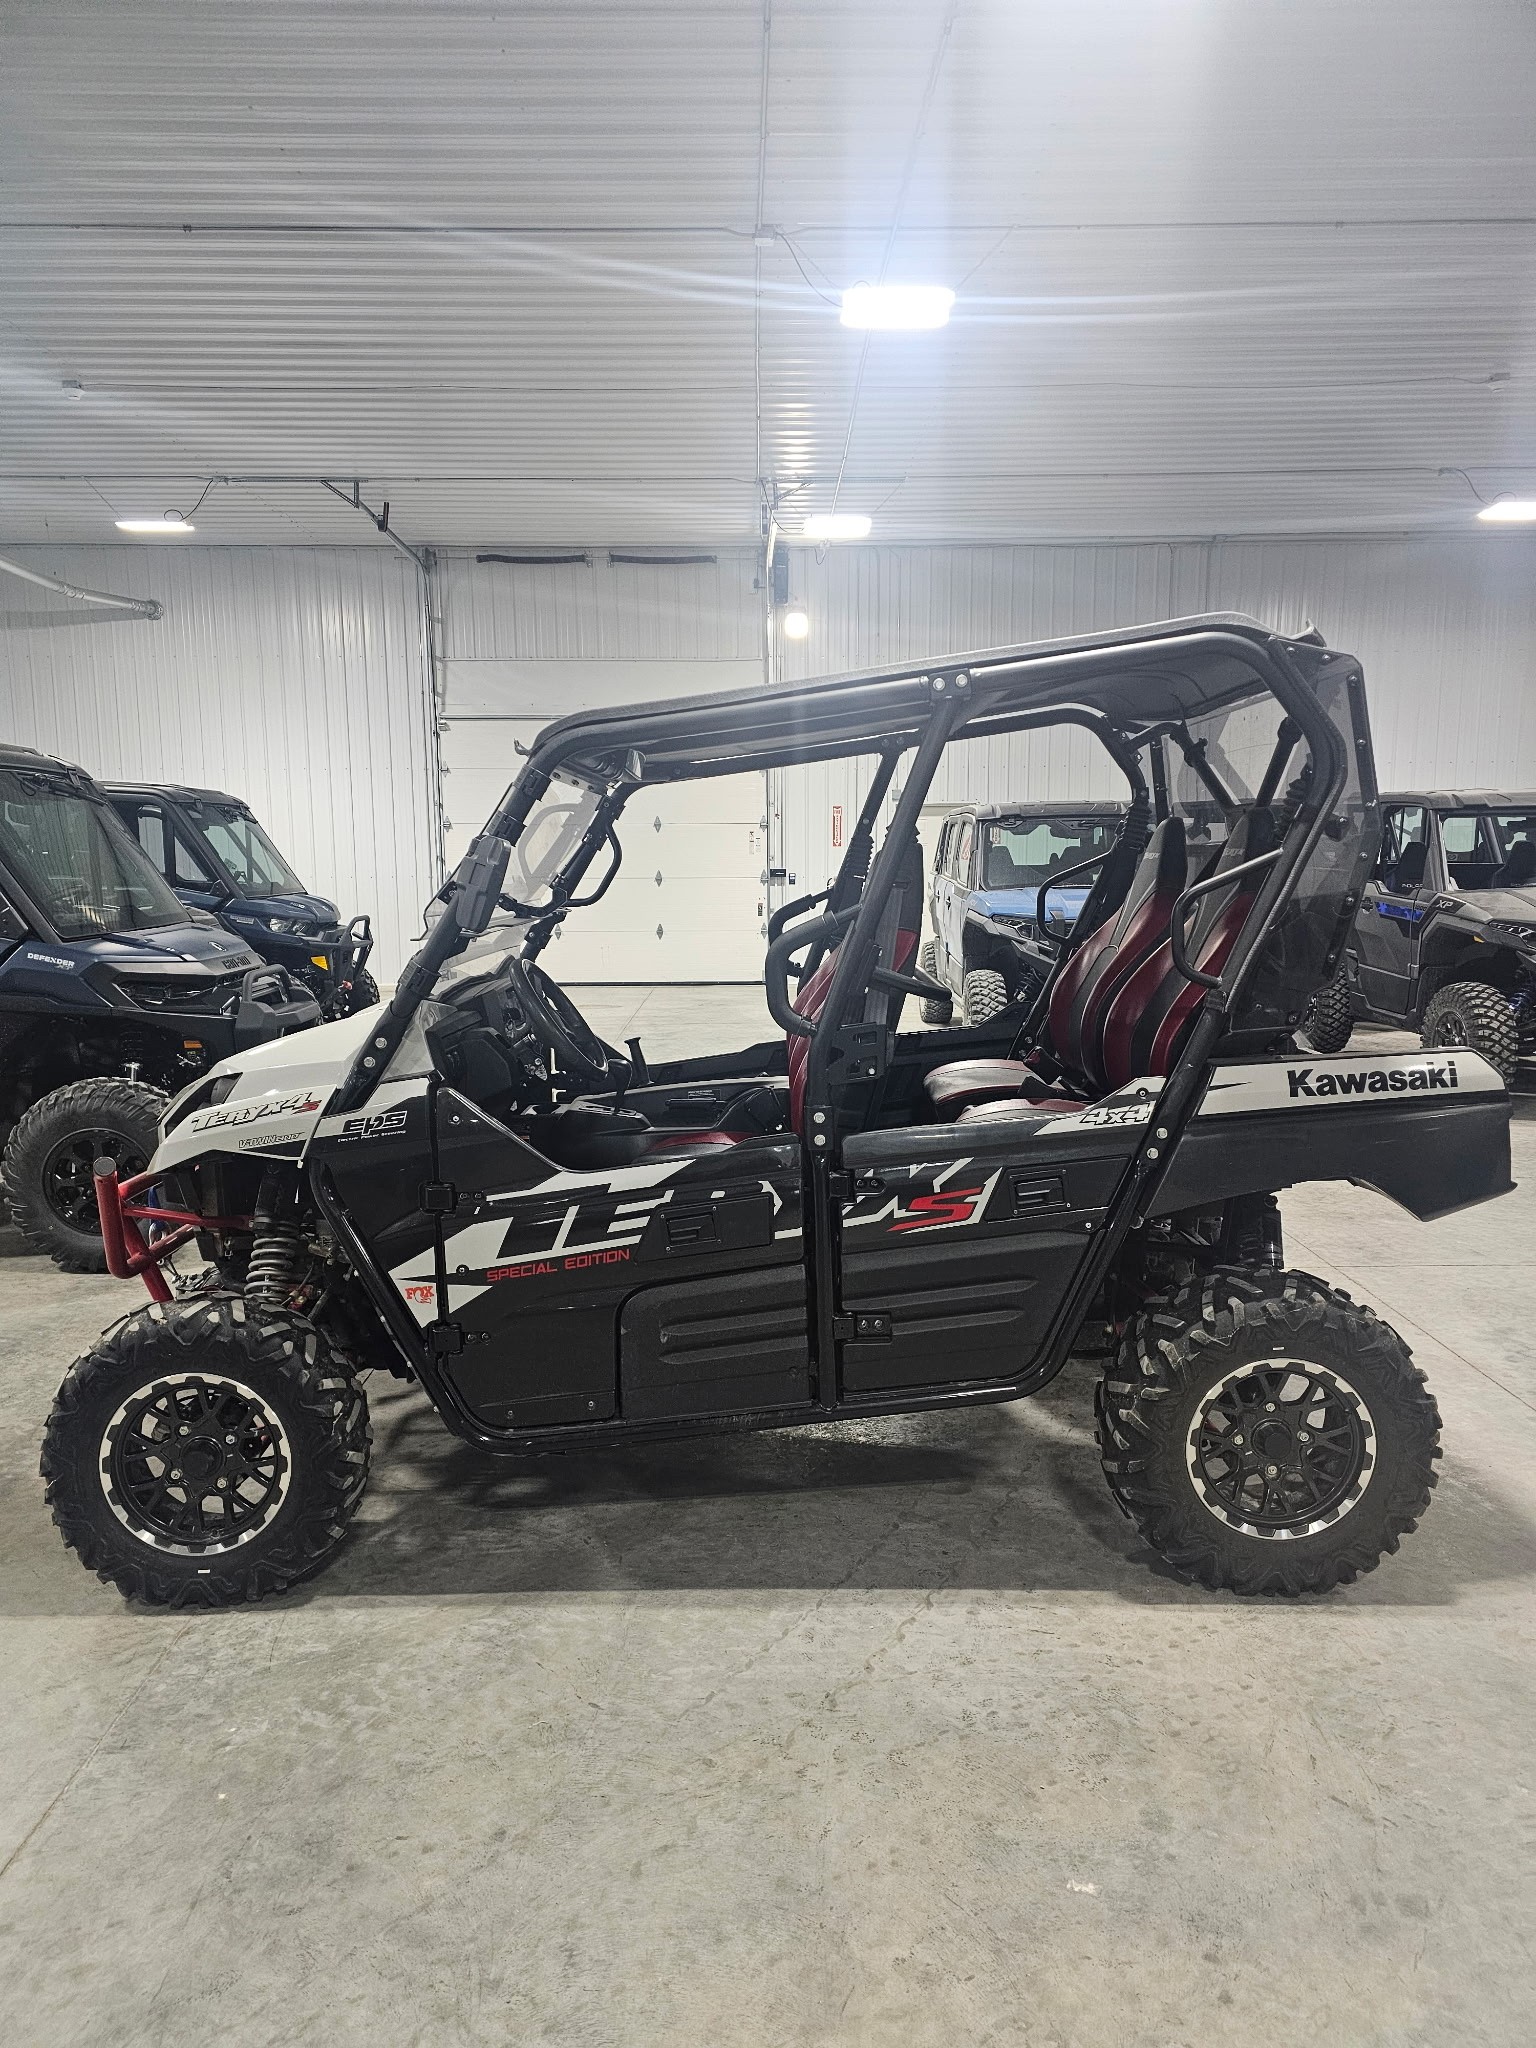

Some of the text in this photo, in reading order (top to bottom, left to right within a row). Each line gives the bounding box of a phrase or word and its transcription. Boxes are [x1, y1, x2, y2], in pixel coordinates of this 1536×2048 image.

[1436, 900, 1454, 909] XP
[27, 952, 75, 967] DEFENDER
[1286, 1060, 1459, 1098] Kawasaki
[486, 1248, 630, 1283] SPECIAL EDITION
[404, 1285, 435, 1305] FOX
